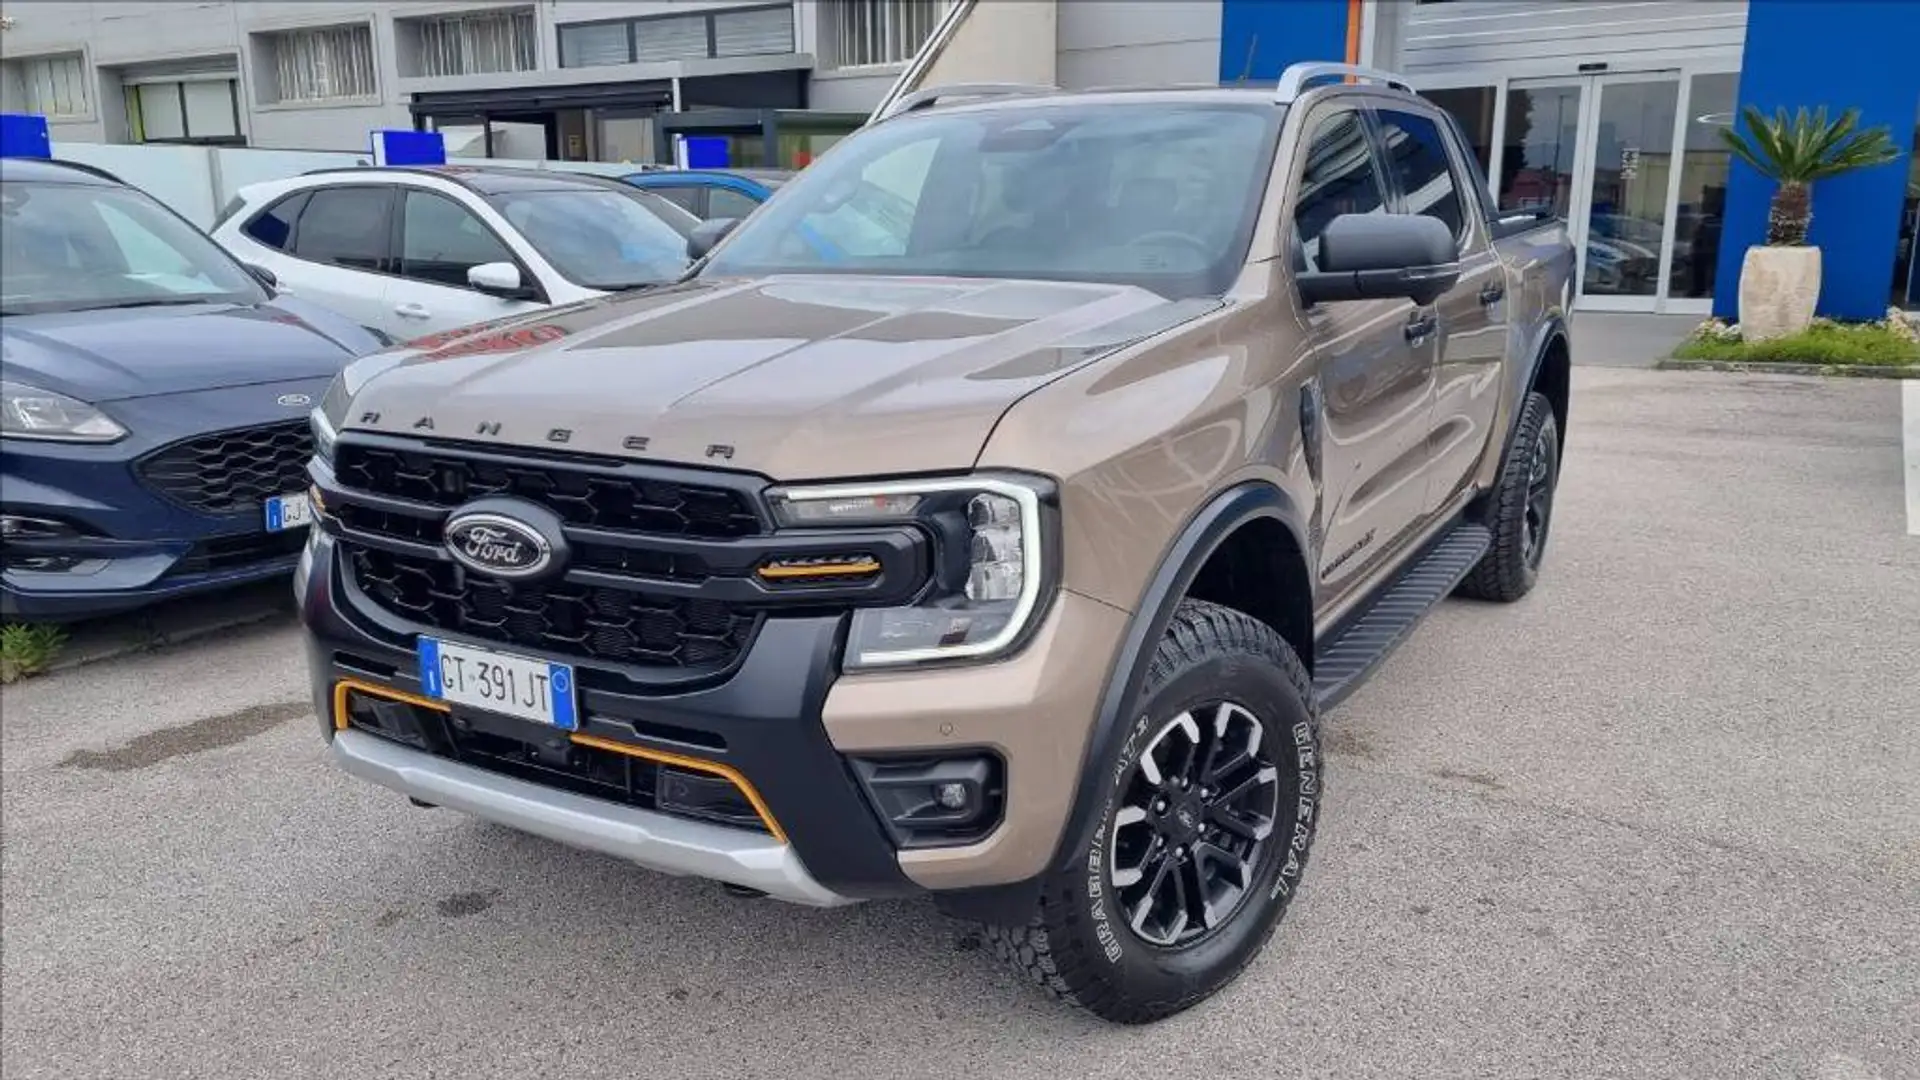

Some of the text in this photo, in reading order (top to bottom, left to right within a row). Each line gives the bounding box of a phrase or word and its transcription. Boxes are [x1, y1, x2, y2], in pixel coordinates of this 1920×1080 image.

[360, 412, 735, 459] RANGER
[465, 526, 522, 564] Ford
[440, 654, 548, 711] GT 391 JT
[1272, 721, 1317, 900] GENERAL
